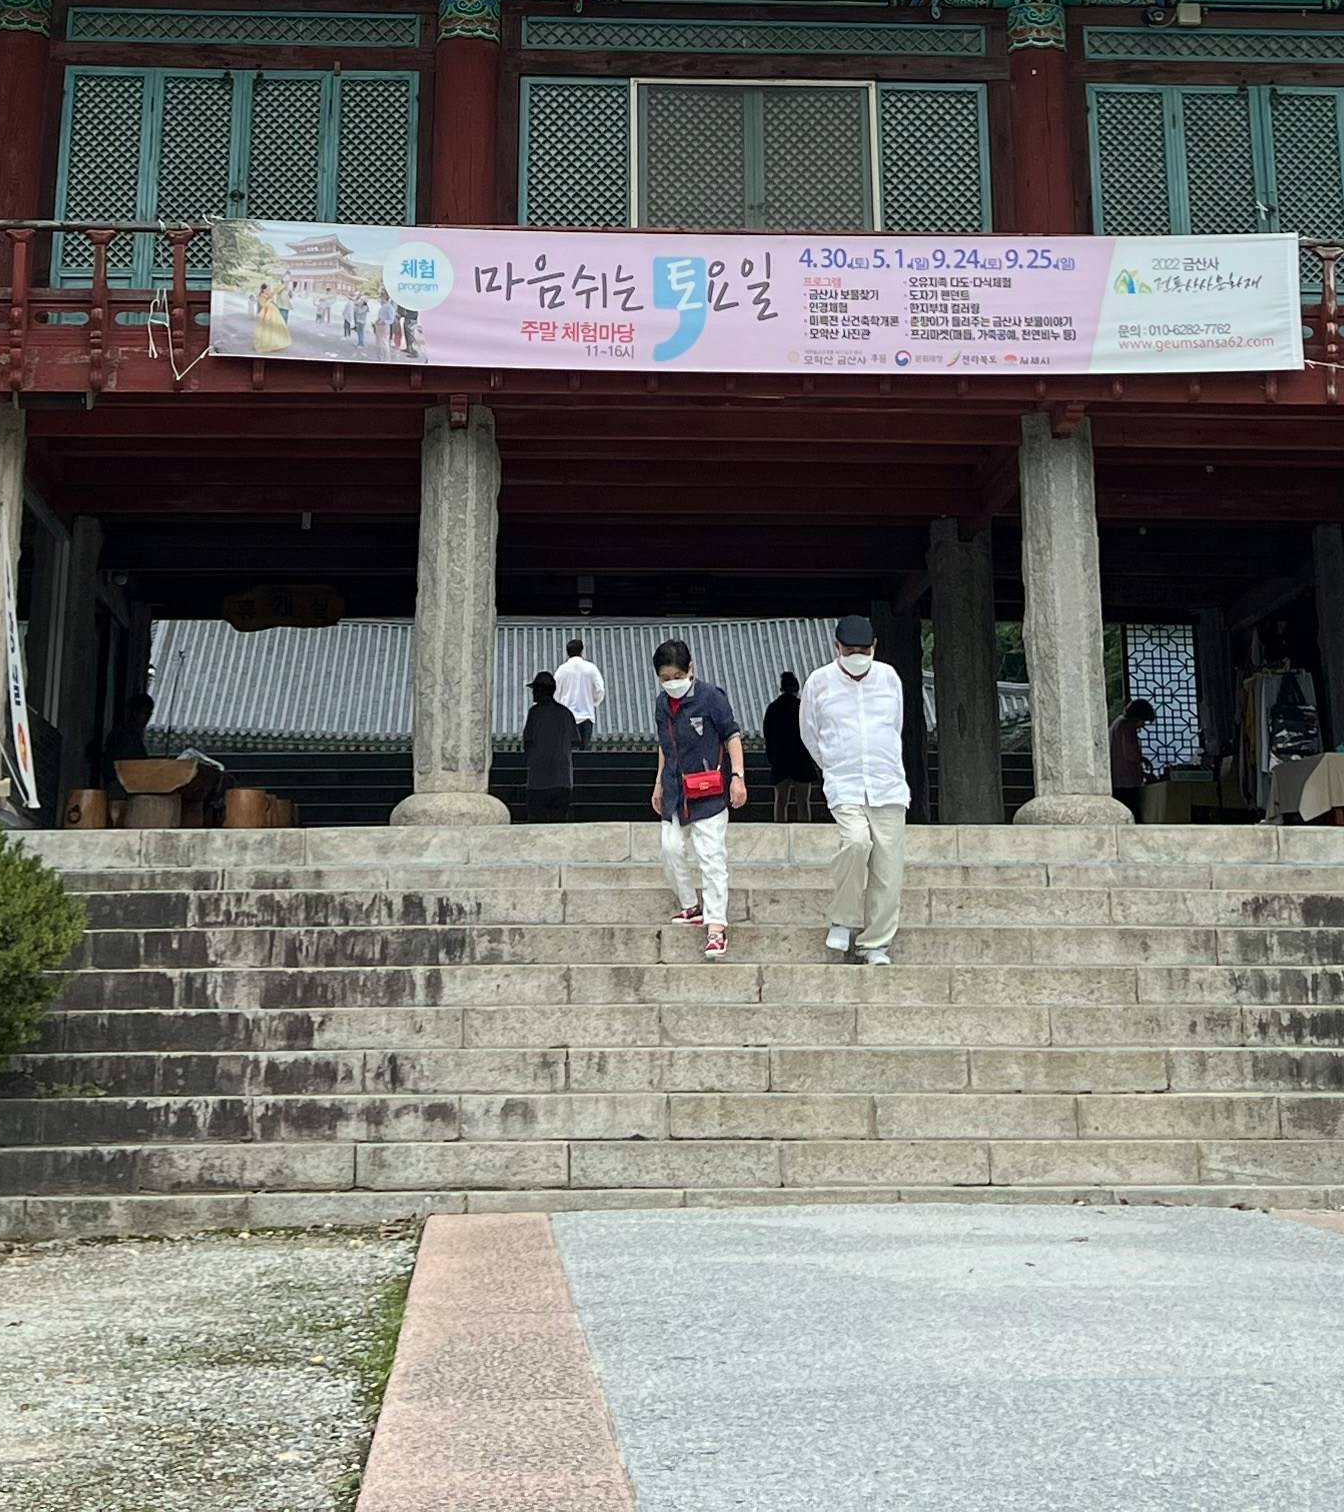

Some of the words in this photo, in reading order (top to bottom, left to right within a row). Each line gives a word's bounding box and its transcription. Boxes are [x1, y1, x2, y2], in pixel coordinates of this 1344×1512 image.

[400, 259, 436, 280] 체험
[1151, 257, 1181, 271] 2022
[1182, 257, 1220, 272] 금산사
[398, 281, 439, 294] program
[474, 254, 644, 312] 마음쉬는
[666, 252, 779, 321] 토요일
[803, 277, 842, 288] 프로그램
[809, 289, 838, 300] 금산사
[840, 289, 879, 300] 보물찾기
[909, 289, 938, 301] 도자기
[909, 302, 949, 314] 한지부채
[951, 303, 980, 314] 컬러링
[951, 316, 991, 328] 들려주는
[992, 316, 1022, 328] 금산사
[1024, 316, 1073, 328] 보물이야기
[520, 320, 558, 342] 주말
[561, 321, 635, 344] 체험마당
[809, 328, 839, 340] 모악산
[841, 328, 871, 340] 사진관
[1021, 328, 1061, 341] 천연비누
[1148, 323, 1232, 336] 010-6282-7762
[1118, 336, 1275, 352] www.geumsansa62.com
[585, 345, 635, 359] 11~16시
[837, 355, 867, 366] 금산사
